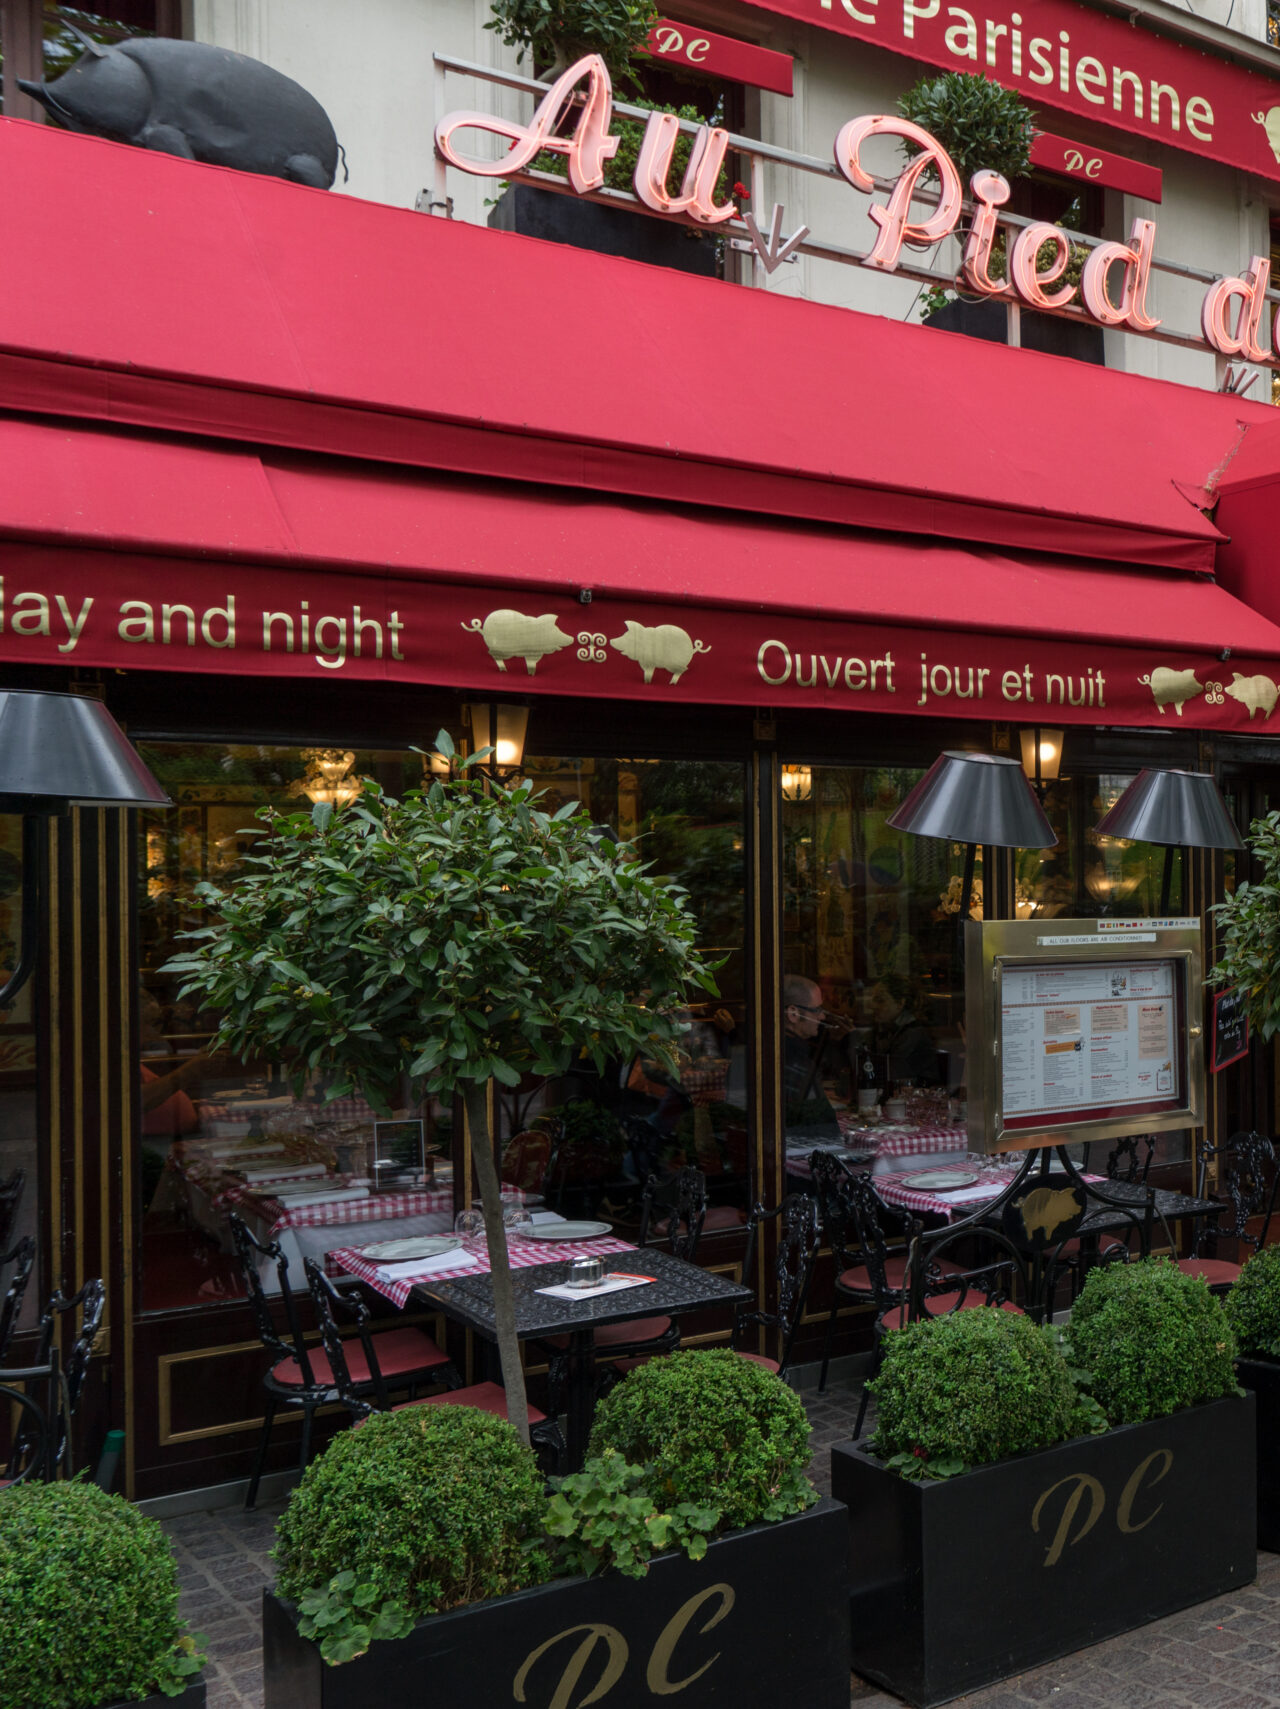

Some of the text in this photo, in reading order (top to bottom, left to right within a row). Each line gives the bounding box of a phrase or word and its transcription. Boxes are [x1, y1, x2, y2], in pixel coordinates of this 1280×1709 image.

[902, 0, 1215, 142] Parisienne
[435, 54, 738, 224] Au
[833, 114, 1163, 331] Pied
[0, 575, 405, 670] ay and night
[756, 639, 1106, 708] Ouvert jour et nuit
